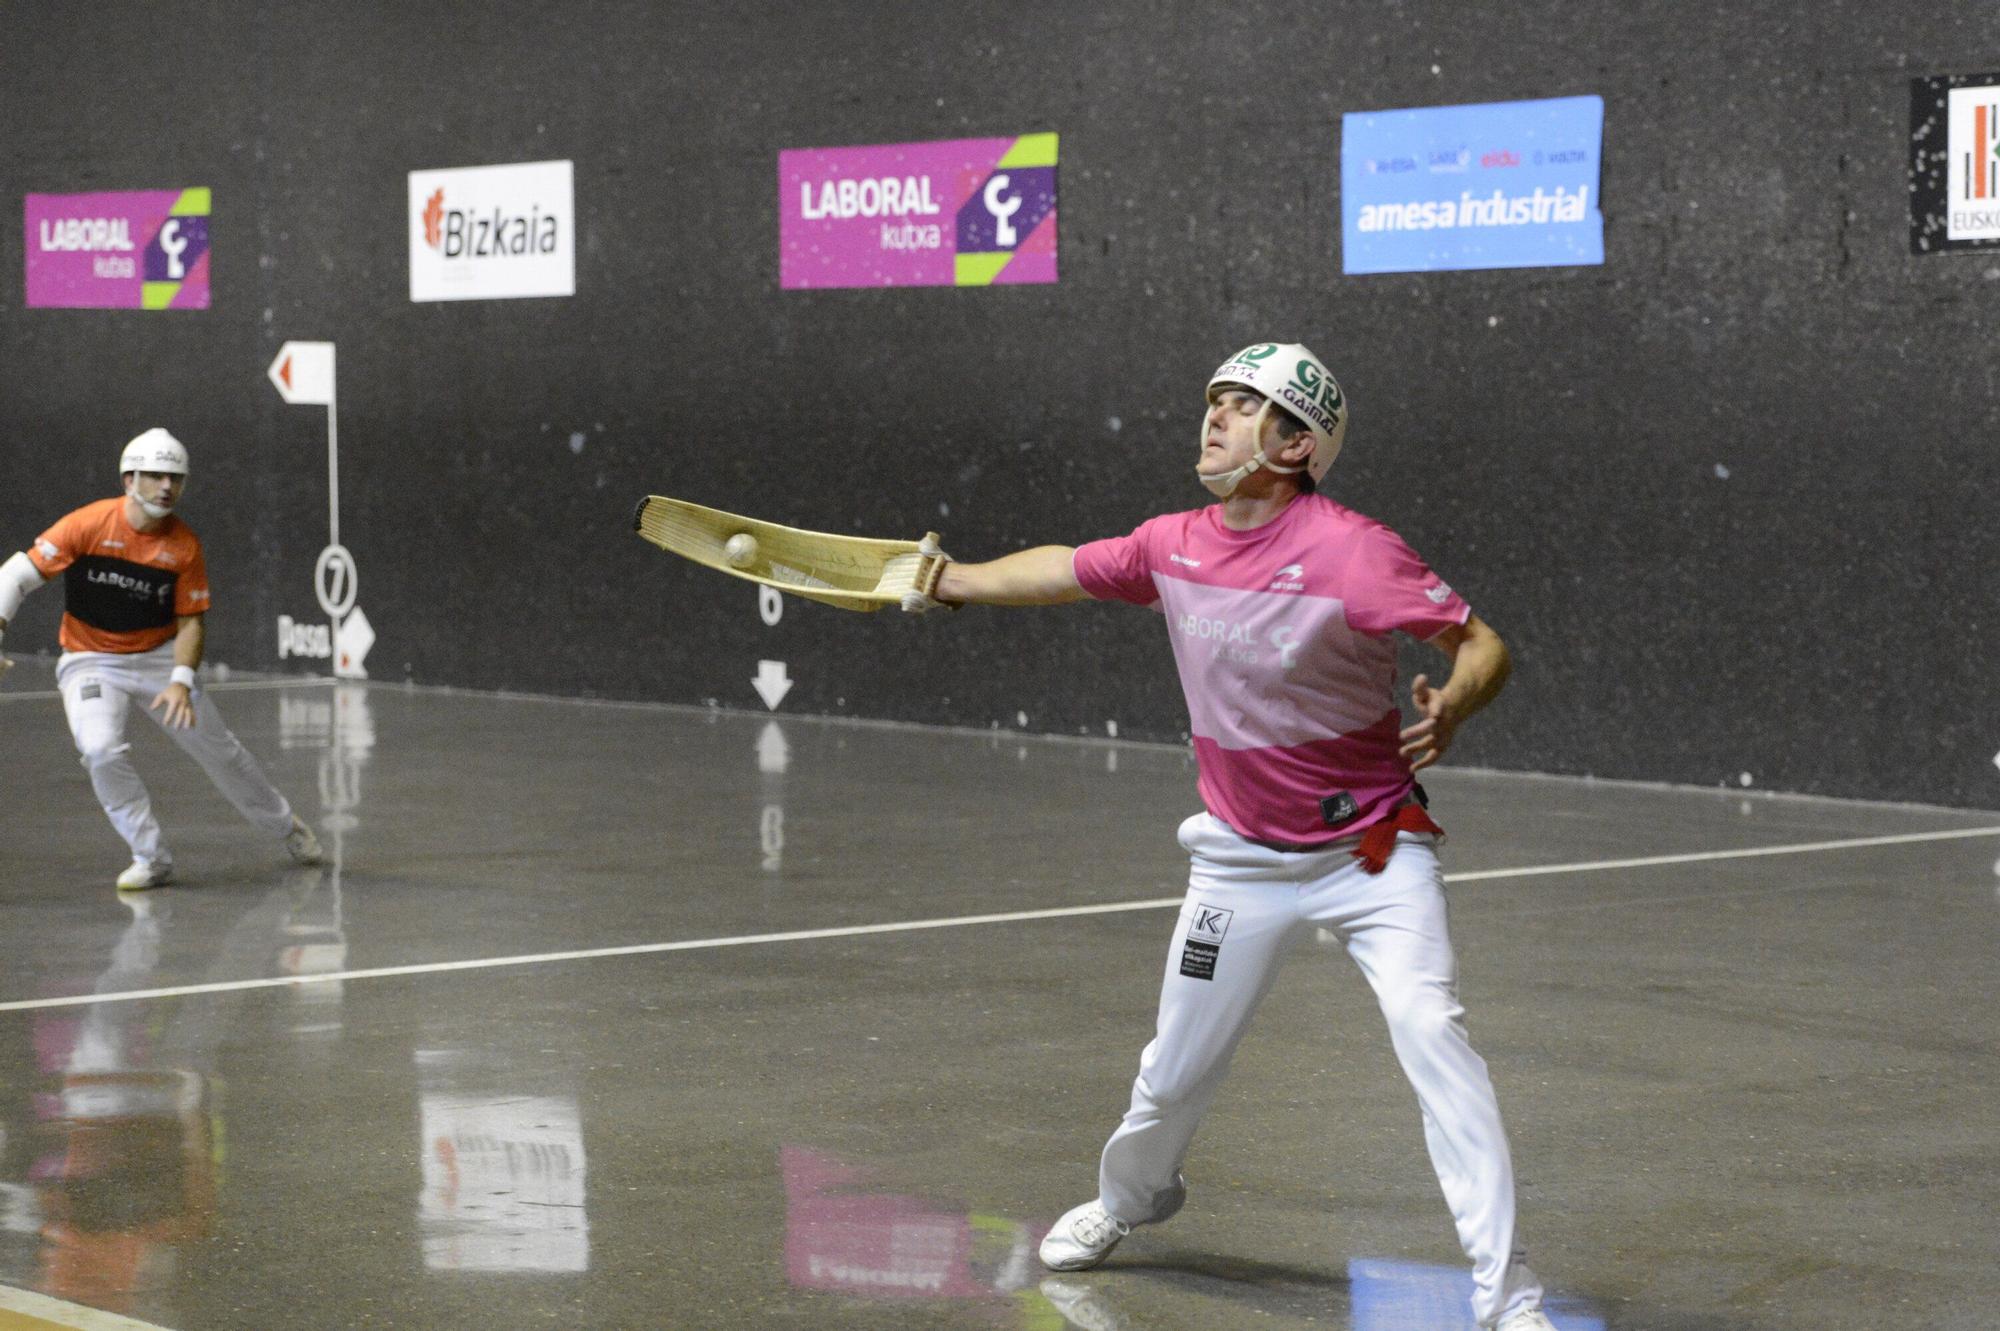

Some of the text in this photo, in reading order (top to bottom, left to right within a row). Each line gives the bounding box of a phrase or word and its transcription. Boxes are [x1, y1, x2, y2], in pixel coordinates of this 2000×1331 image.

[801, 174, 940, 219] LABORAL
[40, 217, 134, 252] LABORAL
[445, 203, 557, 258] Bizkaia
[881, 222, 940, 250] kutxa
